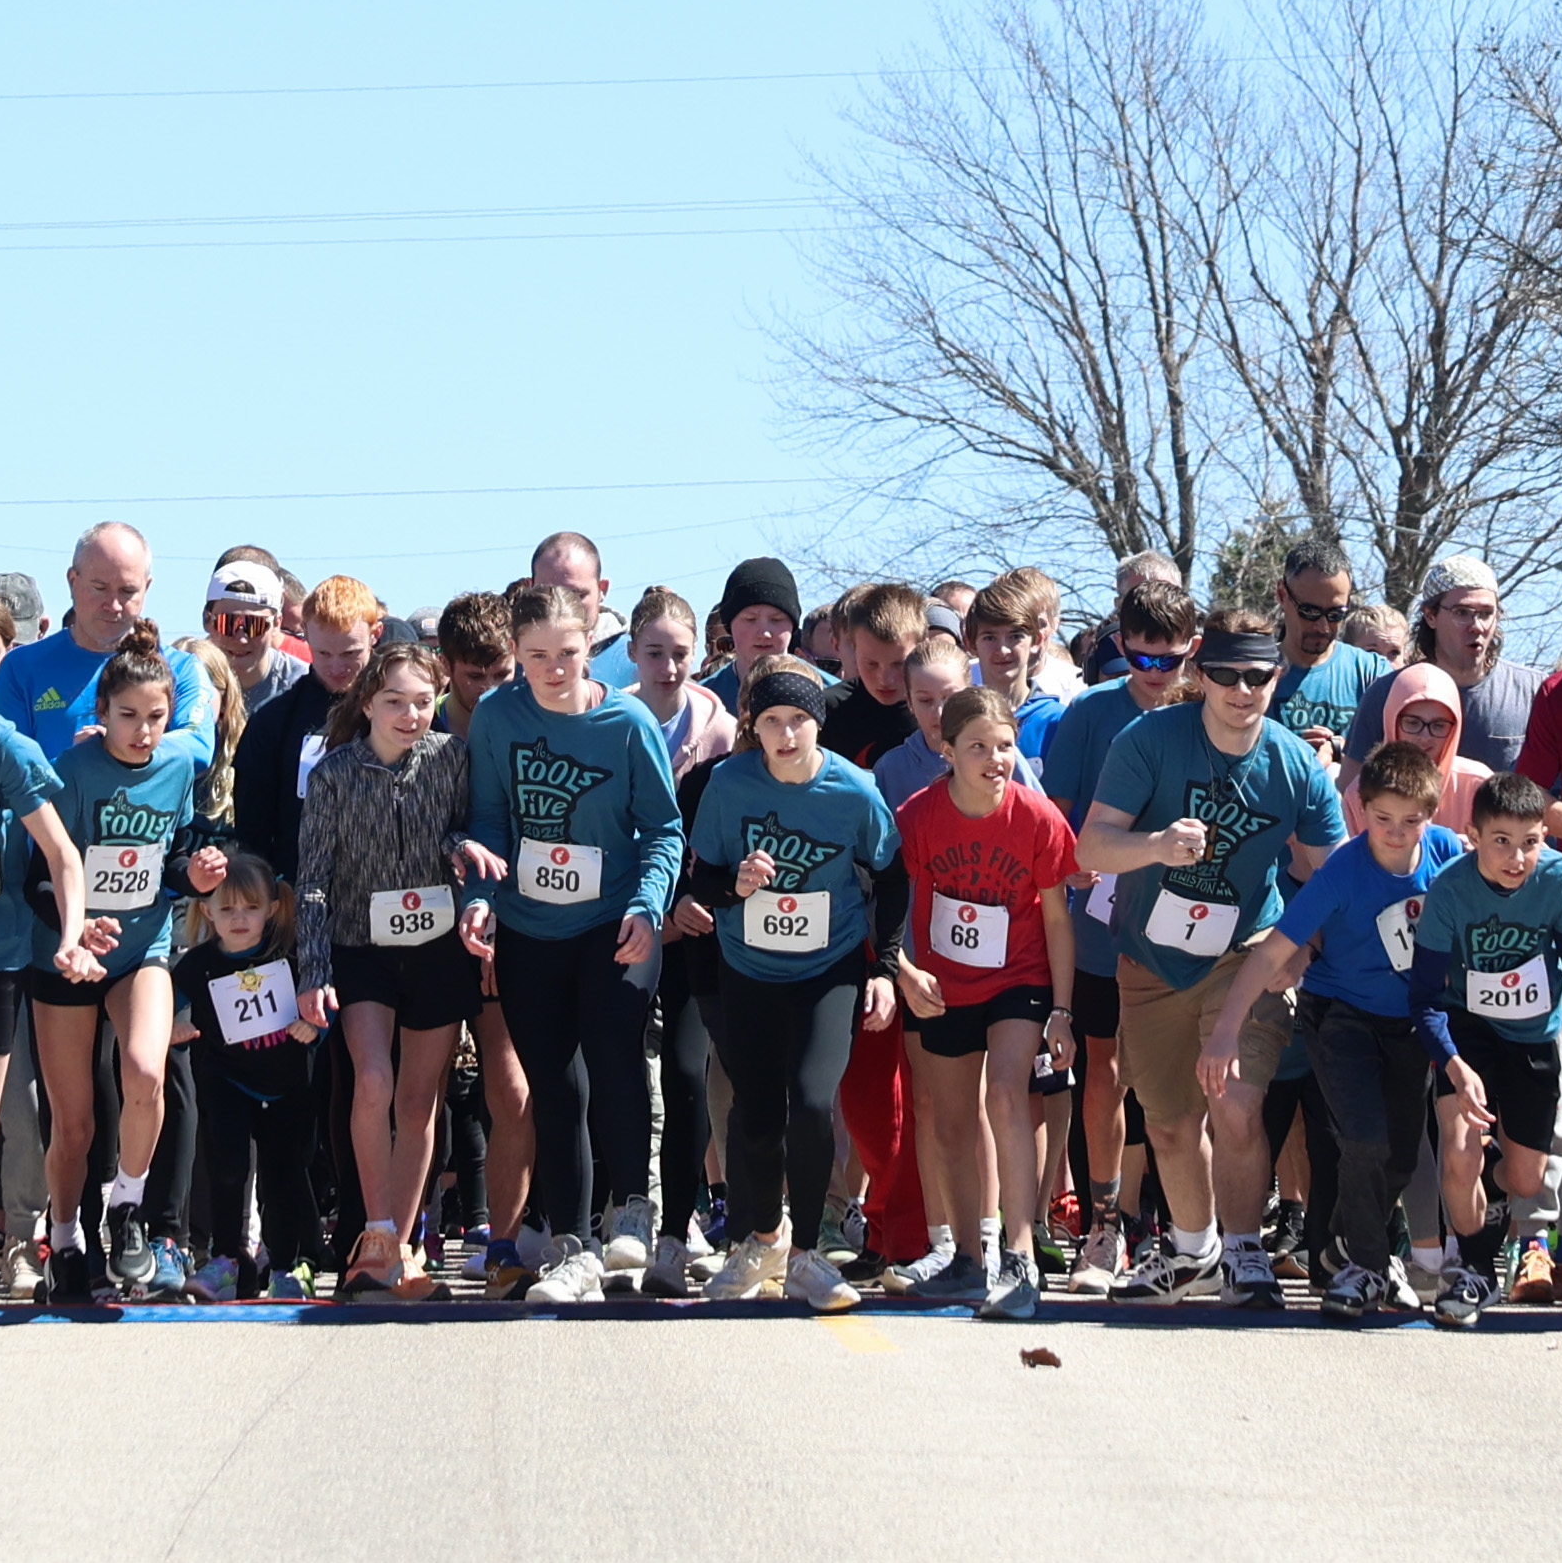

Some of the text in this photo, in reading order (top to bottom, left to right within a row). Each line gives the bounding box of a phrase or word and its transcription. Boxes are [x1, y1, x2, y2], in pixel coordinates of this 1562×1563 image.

[34, 699, 66, 712] adidas
[1280, 702, 1355, 730] FOOLS
[517, 749, 605, 793] FOOLS
[100, 805, 170, 840] FOOLS
[1189, 788, 1271, 837] FOOLS
[523, 824, 565, 838] 2024
[747, 823, 837, 867] FOOLS
[989, 847, 1031, 885] FIVE
[93, 870, 150, 893] 2528
[536, 866, 580, 892] 850
[389, 911, 435, 935] 938
[764, 915, 809, 936] 692
[1185, 922, 1196, 941] 1
[951, 925, 979, 949] 68
[234, 989, 279, 1023] 211
[1479, 983, 1539, 1007] 2016
